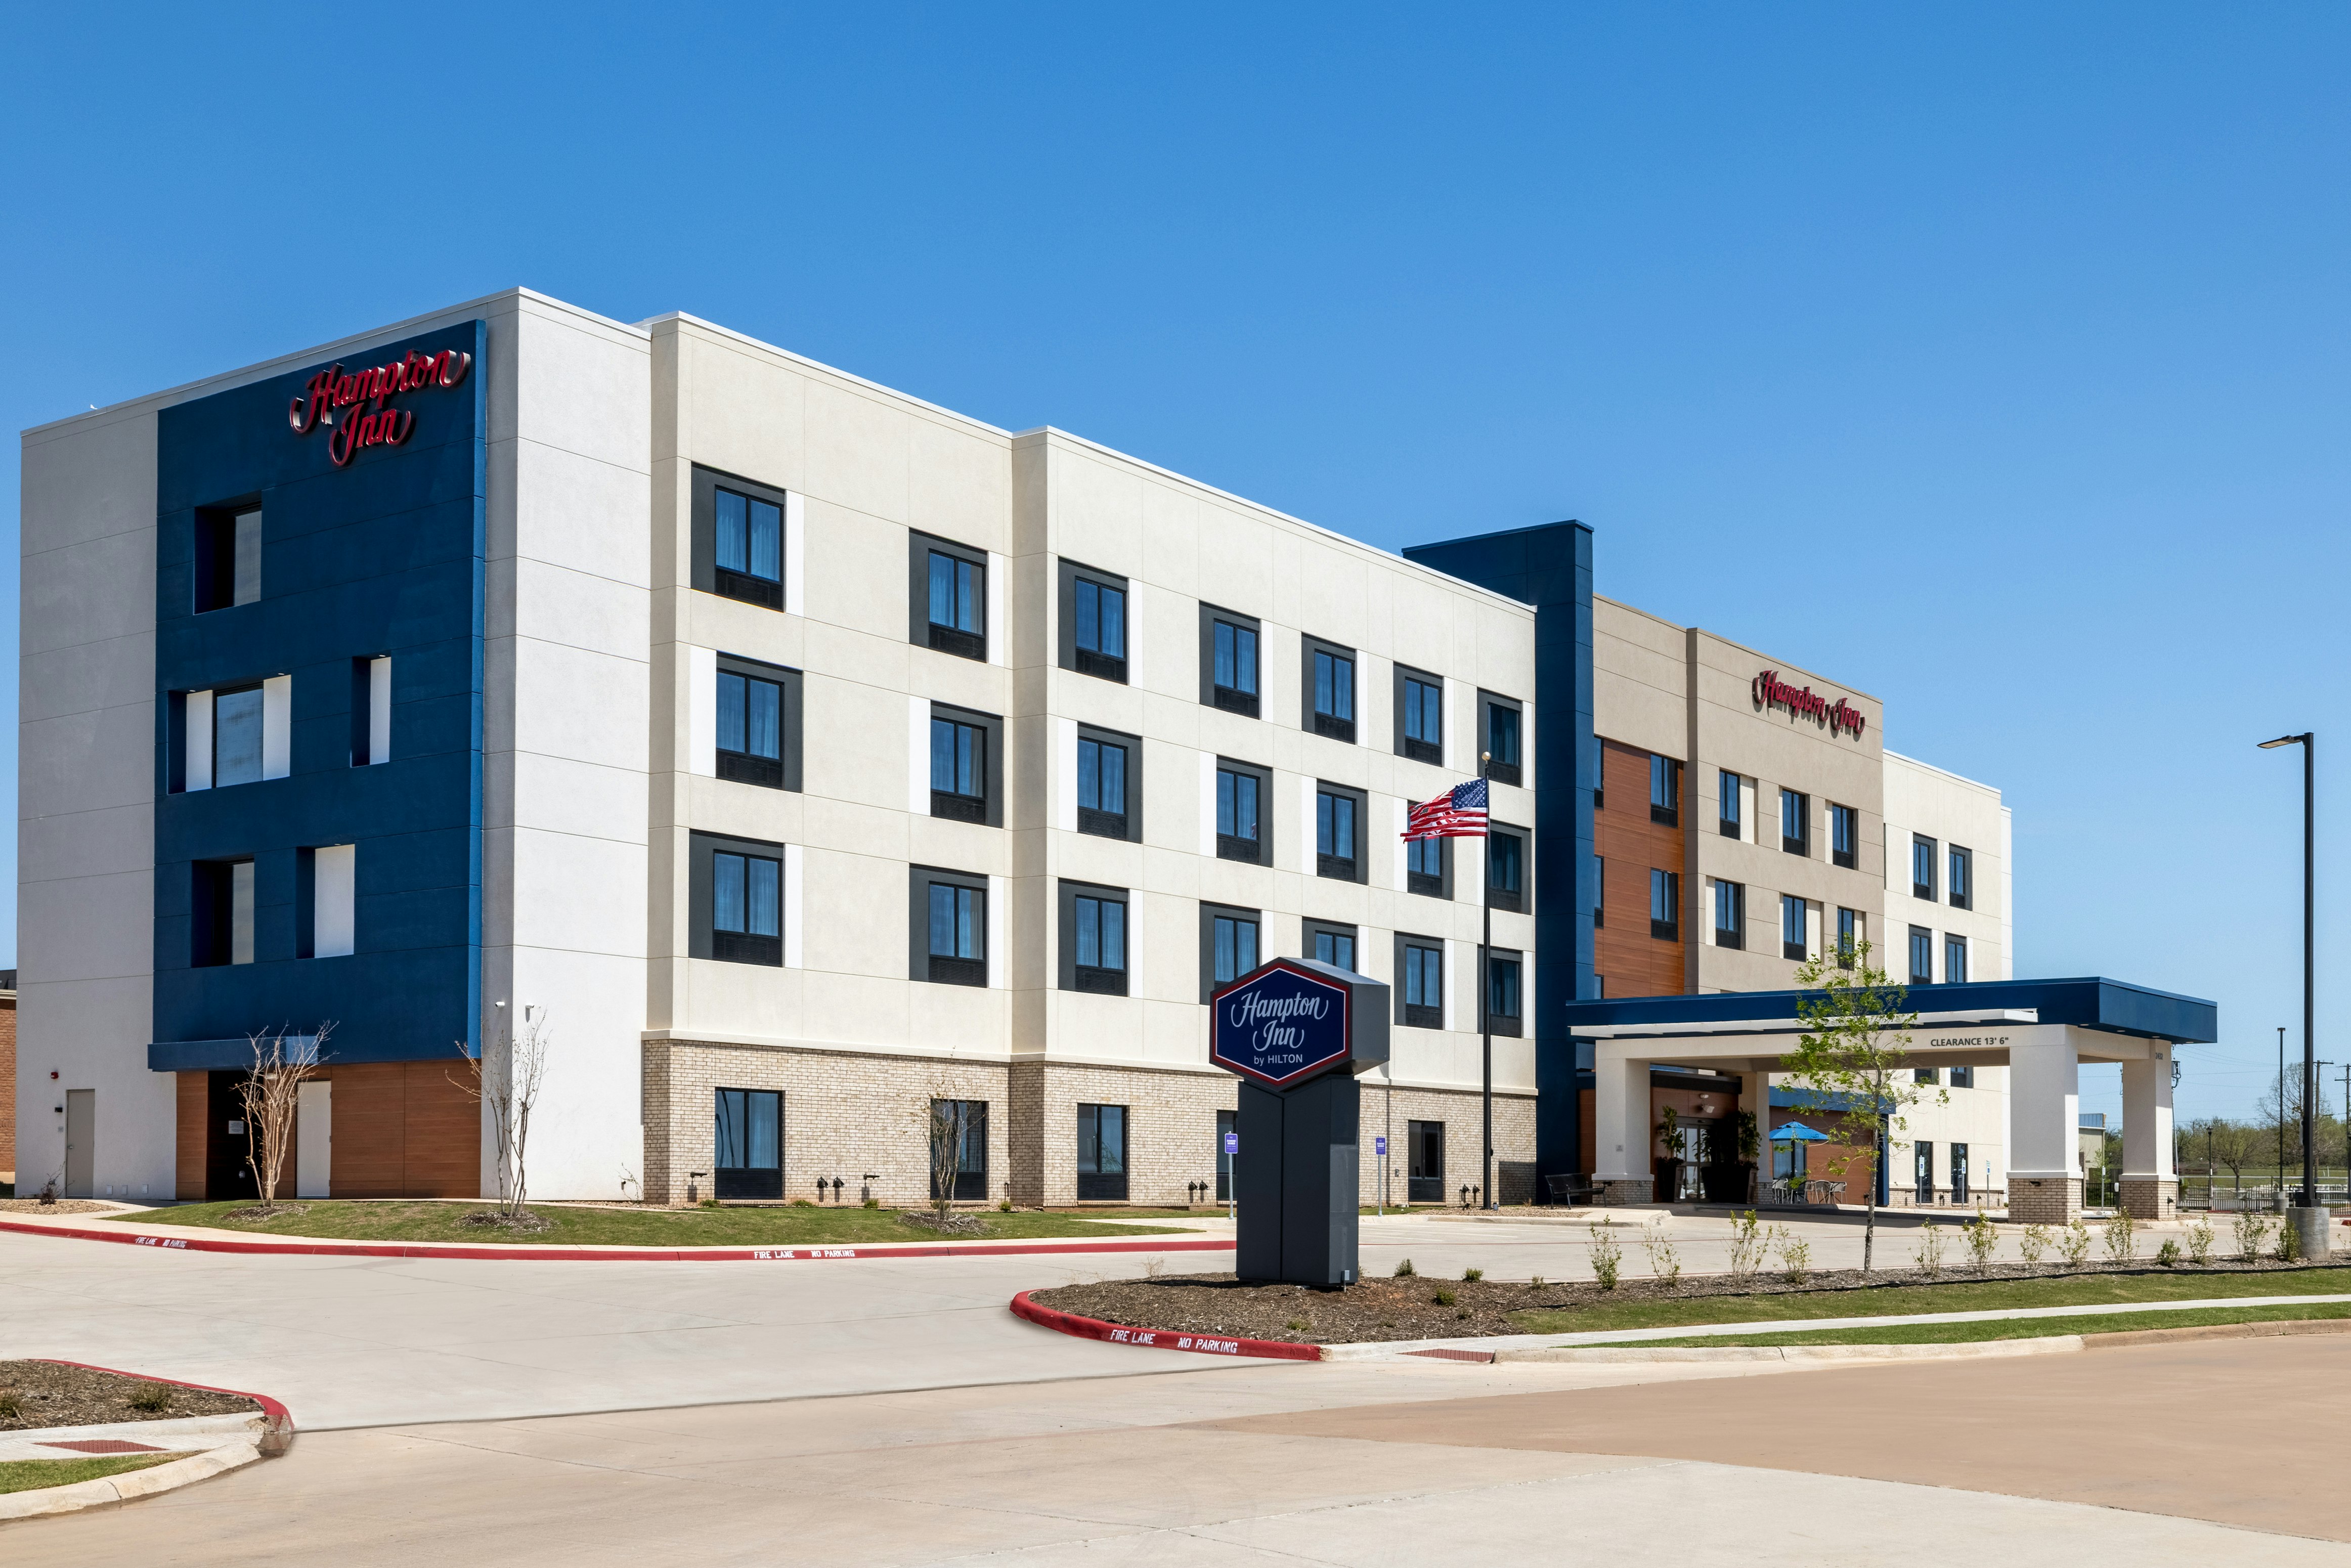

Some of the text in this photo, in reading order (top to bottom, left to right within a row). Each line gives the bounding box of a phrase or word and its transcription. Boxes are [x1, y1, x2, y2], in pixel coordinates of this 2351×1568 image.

[290, 349, 471, 433] Hampton
[329, 403, 417, 466] Inn
[1752, 670, 1865, 734] Hampton Inn
[1231, 990, 1329, 1028] Hampton
[1252, 1019, 1304, 1052] Inn
[1931, 1038, 1981, 1046] CLEARANCE
[1254, 1054, 1302, 1066] by HILTON
[169, 1240, 187, 1248] PARKING
[1110, 1329, 1238, 1354] FIRE LANE NO PARKING
